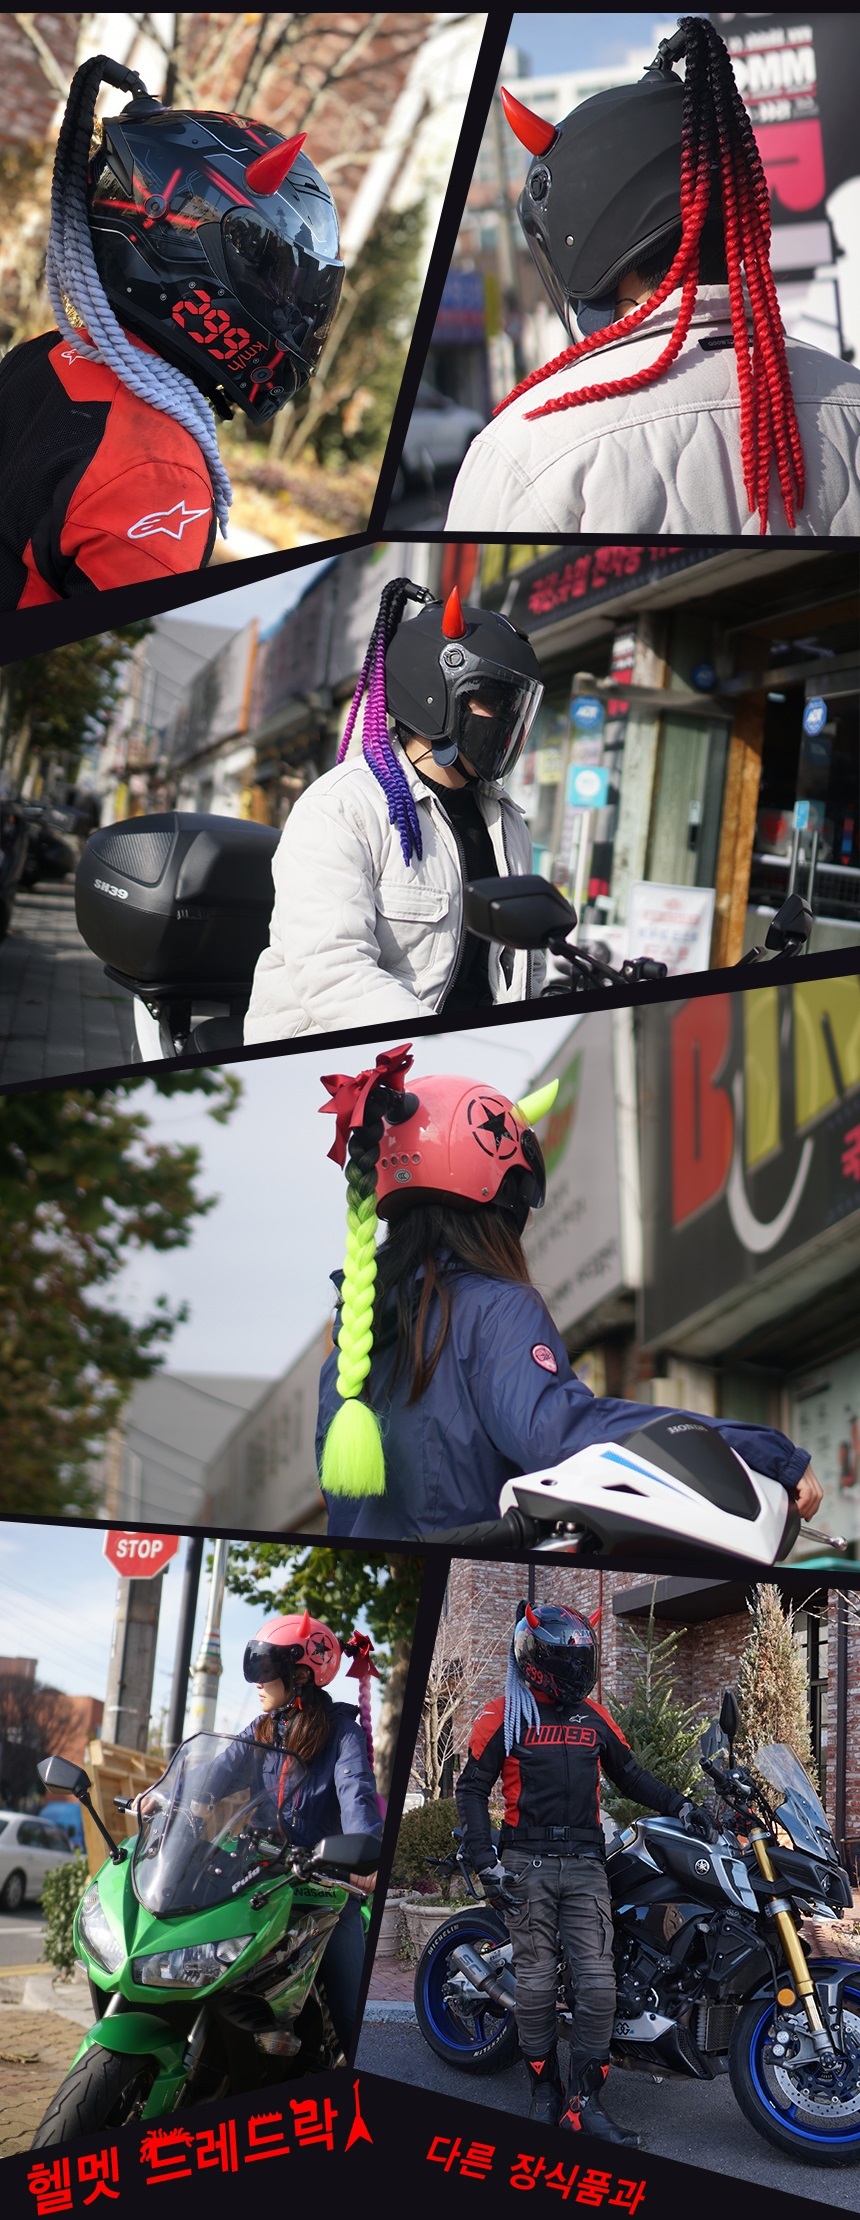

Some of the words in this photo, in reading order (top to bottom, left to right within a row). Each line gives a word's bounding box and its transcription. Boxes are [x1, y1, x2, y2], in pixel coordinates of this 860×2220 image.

[172, 289, 250, 360] 299
[227, 341, 269, 371] km/h
[93, 878, 129, 900] SH39
[116, 1538, 164, 1559] STOP
[525, 1660, 544, 1685] 299
[427, 1924, 460, 1956] MICHELIN
[472, 2025, 508, 2057] MICHELIN
